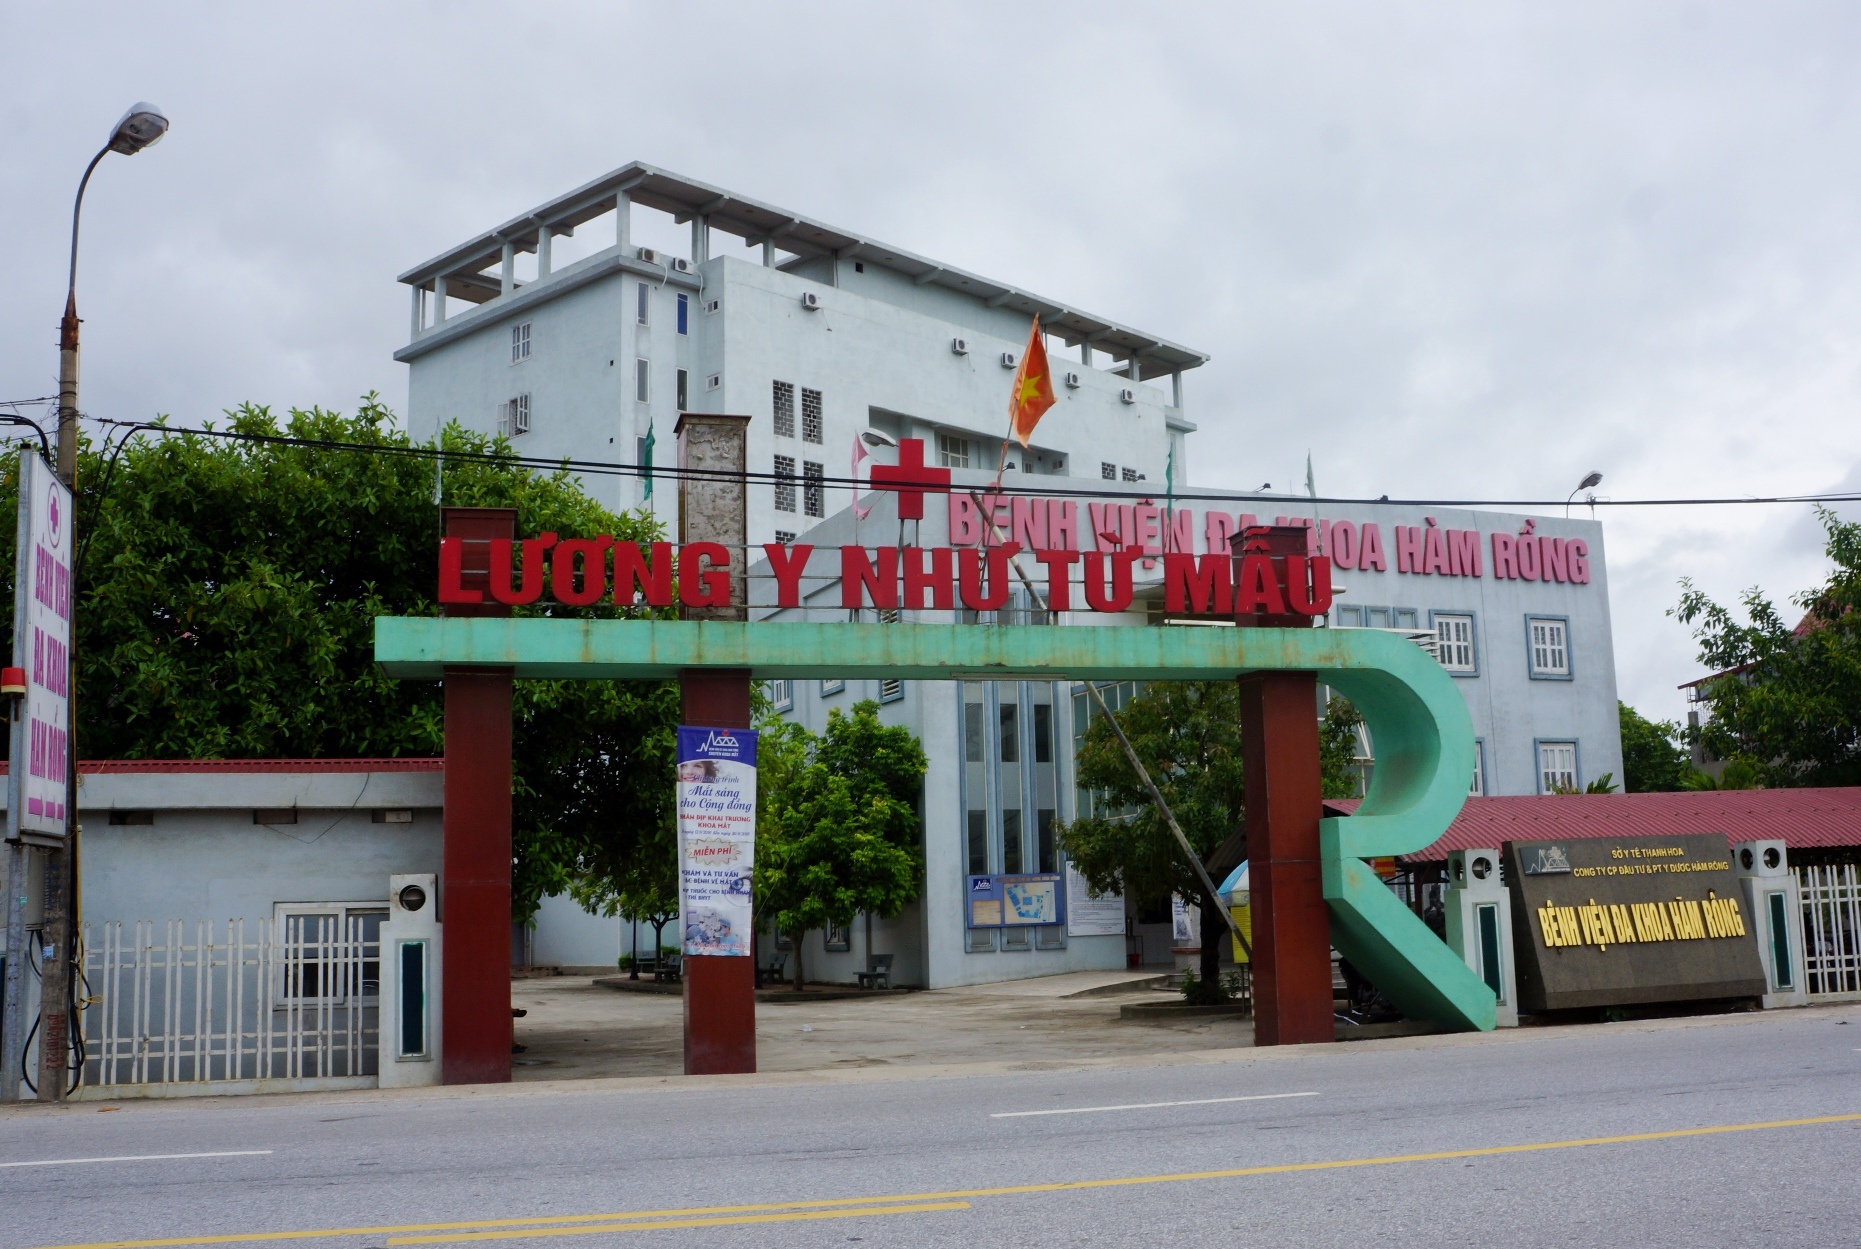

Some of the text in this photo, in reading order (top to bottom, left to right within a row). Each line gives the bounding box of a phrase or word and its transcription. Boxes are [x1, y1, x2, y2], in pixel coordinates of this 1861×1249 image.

[1394, 517, 1482, 577] HÀM
[1491, 518, 1590, 584] RỒNG
[438, 532, 731, 607] LƯƠNG
[763, 543, 814, 607] Y
[841, 542, 1021, 611] NHƯ
[1164, 525, 1333, 615] MẪU
[46, 634, 67, 699] KHOA
[688, 785, 740, 801] Mắt sáng
[699, 798, 725, 812] Cộng
[727, 798, 752, 813] đồng
[693, 844, 732, 857] MIỄN PHÍ
[1611, 846, 1623, 859] SỞ
[1623, 849, 1629, 858] Y
[1641, 848, 1667, 858] THANH
[1596, 866, 1606, 876] TY
[1606, 866, 1618, 876] CP
[1635, 864, 1646, 874] TƯ
[1646, 865, 1653, 874] &
[1652, 865, 1662, 874] PT
[1663, 865, 1670, 873] Y
[1577, 898, 1616, 952] VIỆN
[1609, 903, 1637, 944] ĐA
[1630, 902, 1675, 943] KHOA
